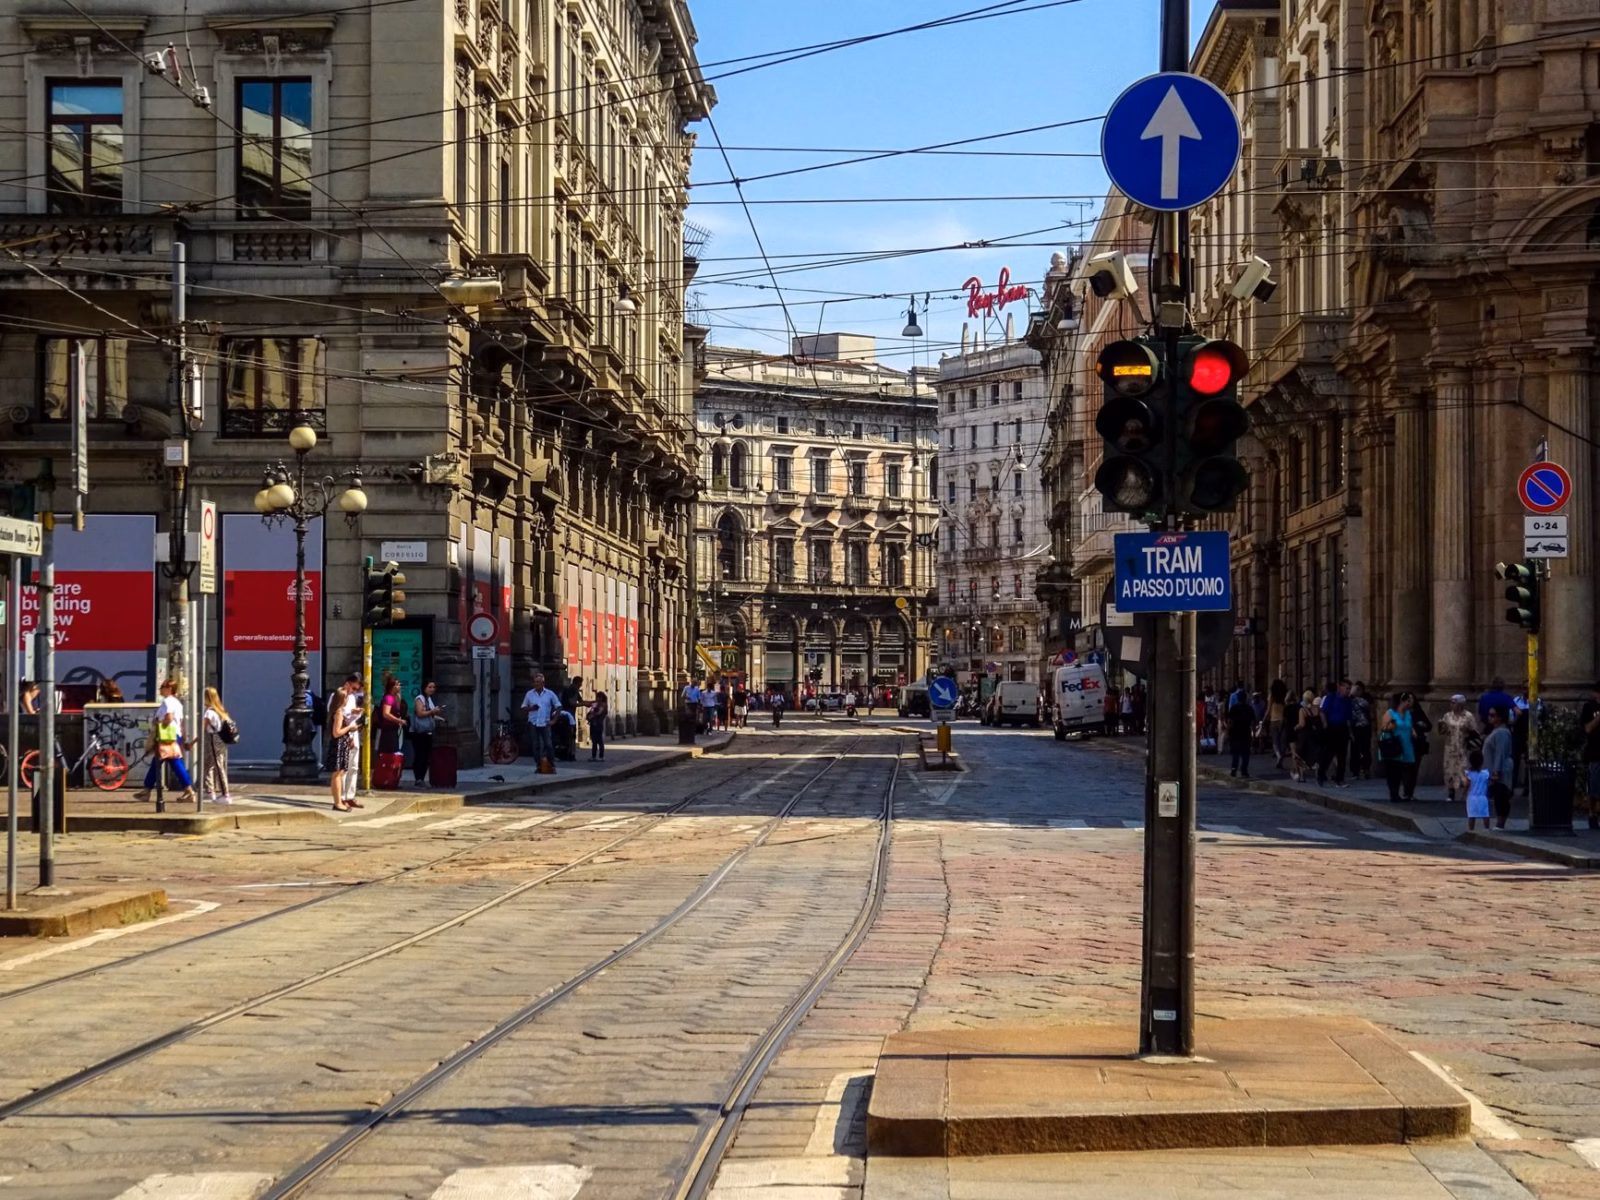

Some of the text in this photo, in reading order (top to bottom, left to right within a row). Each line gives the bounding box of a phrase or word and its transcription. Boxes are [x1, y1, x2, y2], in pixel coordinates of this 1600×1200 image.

[1533, 522, 1558, 530] 0-24
[1141, 546, 1202, 574] TRAM
[53, 583, 82, 595] are
[1122, 577, 1224, 598] A PASSO D'UOMO
[22, 615, 32, 626] a
[1061, 678, 1101, 694] FedEx
